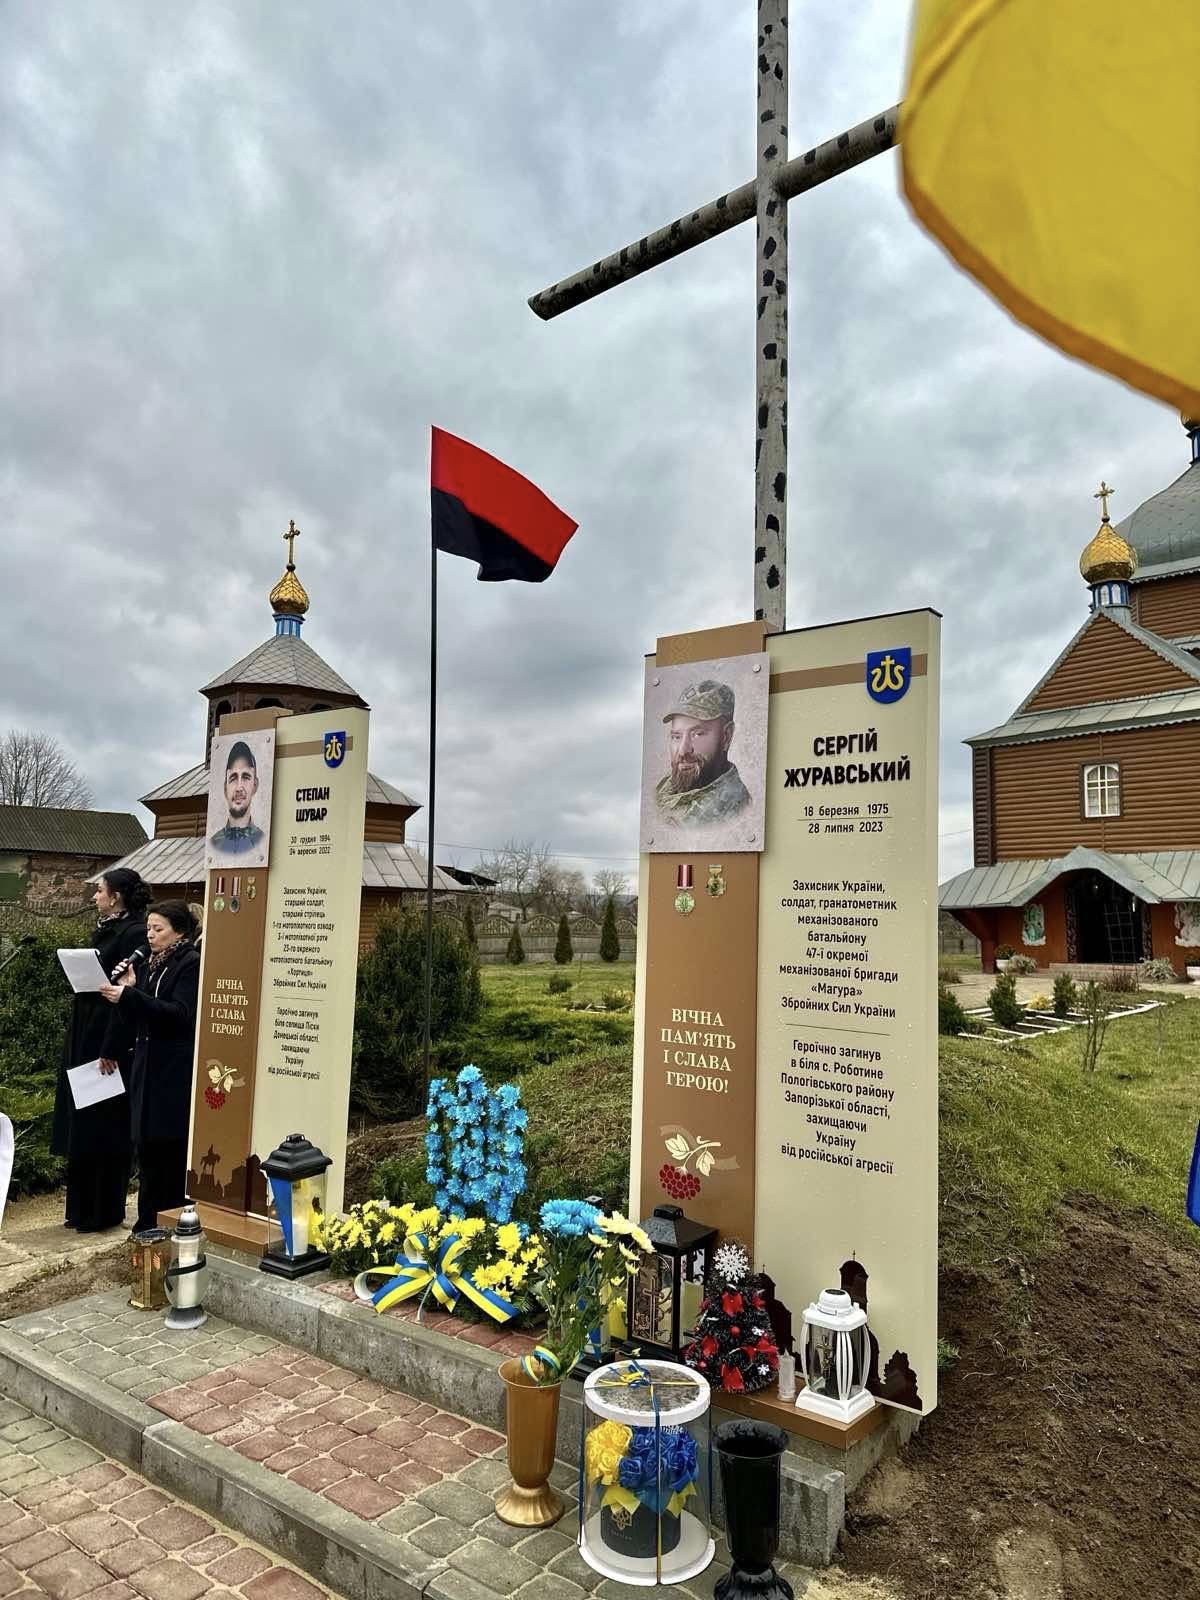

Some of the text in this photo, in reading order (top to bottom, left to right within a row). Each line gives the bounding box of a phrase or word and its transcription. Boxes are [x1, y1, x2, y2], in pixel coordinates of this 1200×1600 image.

[813, 728, 878, 756] СЕРГІЙ
[784, 756, 911, 788] ЖУРАВСЬКИЙ
[296, 787, 330, 802] СТЕПАН
[296, 808, 328, 822] ШУВАР
[804, 804, 889, 818] 18 березня 1975
[808, 822, 883, 834] 28 липня 2023
[793, 880, 885, 893] Захисник України,
[285, 898, 306, 907] старший
[782, 898, 897, 910] солдат, гранатометник
[283, 910, 303, 919] старший
[798, 914, 878, 927] механізованого
[808, 931, 866, 946] батальйону
[806, 948, 868, 962] 47-ї окремої
[780, 964, 898, 983] механізованої бригади
[216, 979, 243, 990] ВІЧНА
[273, 978, 296, 988] Збройних
[308, 981, 326, 990] України
[811, 983, 862, 998] «Магура»
[210, 994, 248, 1005] ПАМ'ЯТЬ
[210, 1008, 245, 1020] І СЛАВА
[782, 997, 896, 1018] Збройних Сил України
[672, 1008, 724, 1026] ВІЧНА
[212, 1023, 243, 1036] ГЕРОЮ!
[660, 1028, 736, 1049] ПАМ'ЯТЬ
[793, 1040, 881, 1062] Героїчно загинув
[664, 1050, 731, 1071] І СЛАВА
[791, 1058, 884, 1079] в біля с. Роботине
[666, 1071, 728, 1093] ГЕРОЮ!
[781, 1073, 894, 1102] Пологівського району
[785, 1090, 890, 1120] Запорізької області,
[806, 1114, 867, 1132] захищаючи
[816, 1131, 856, 1151] Україну
[782, 1143, 893, 1174] від російської агресії
